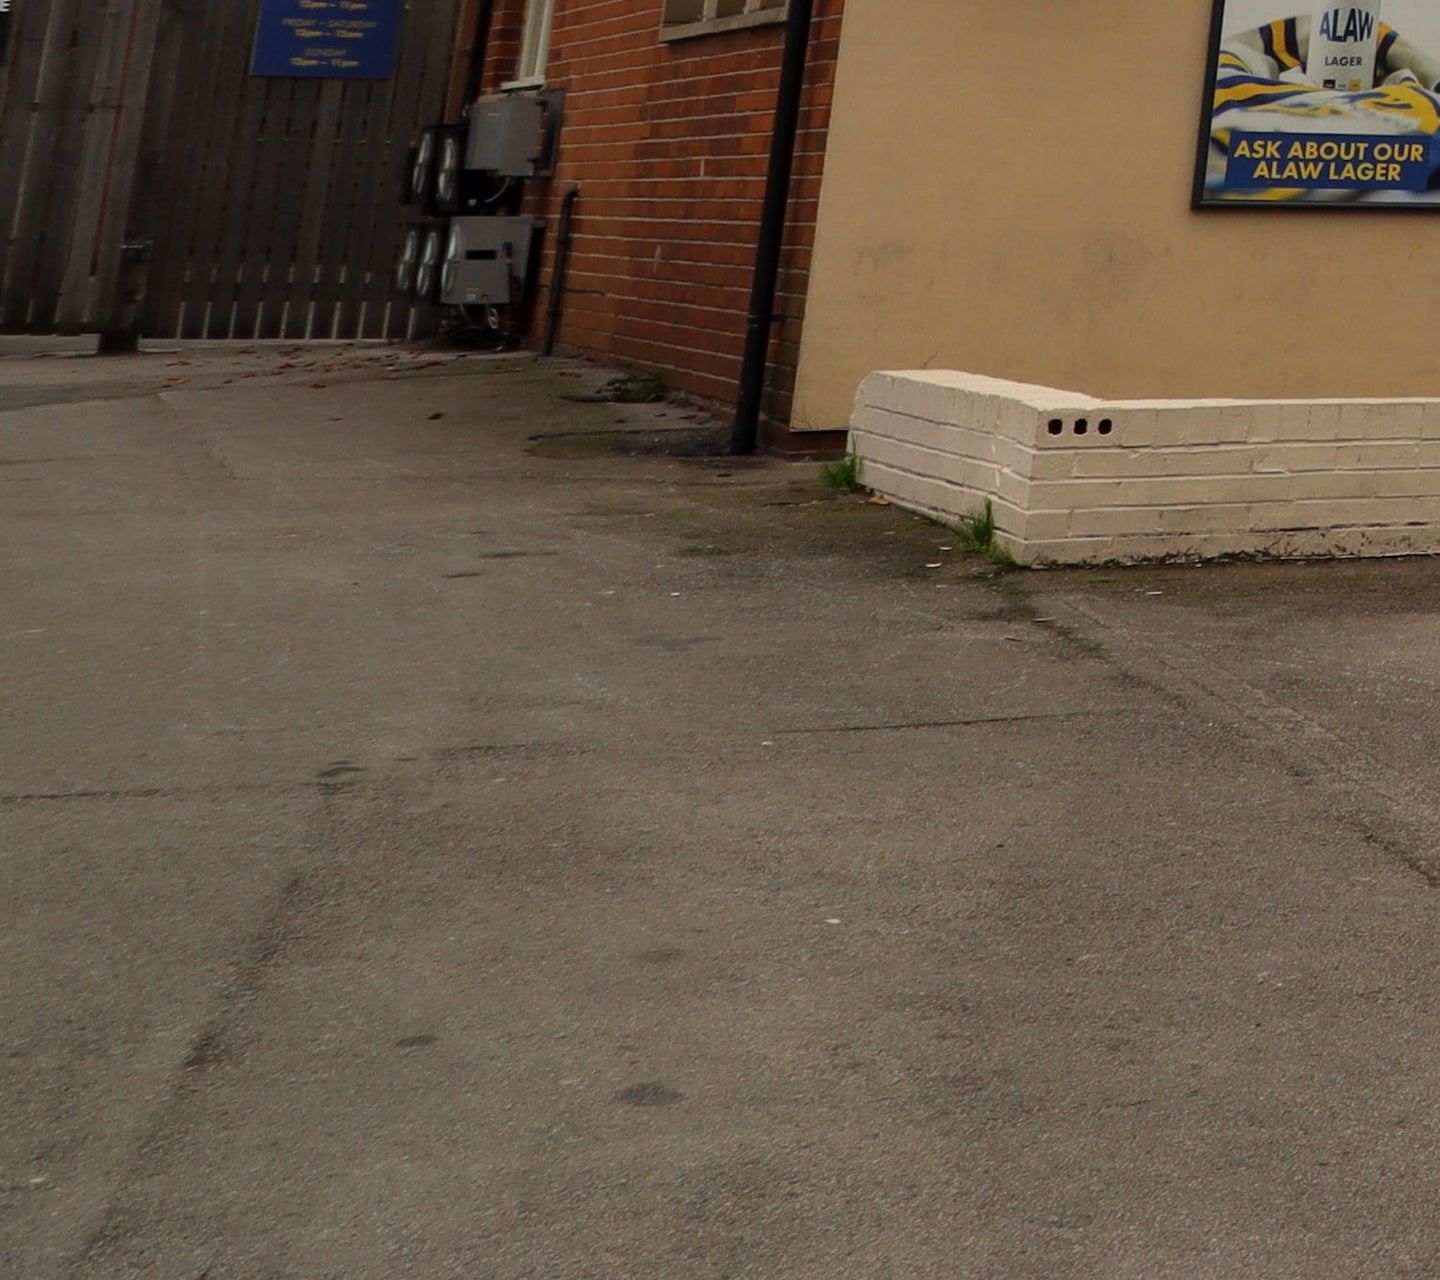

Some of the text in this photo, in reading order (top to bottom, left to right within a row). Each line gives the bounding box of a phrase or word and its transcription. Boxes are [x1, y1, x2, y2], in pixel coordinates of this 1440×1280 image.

[1320, 8, 1373, 42] ALAW
[1325, 56, 1363, 66] LAGER
[1234, 140, 1424, 162] ASK ABOUT OUR
[1253, 161, 1401, 181] ALAW LAGER
